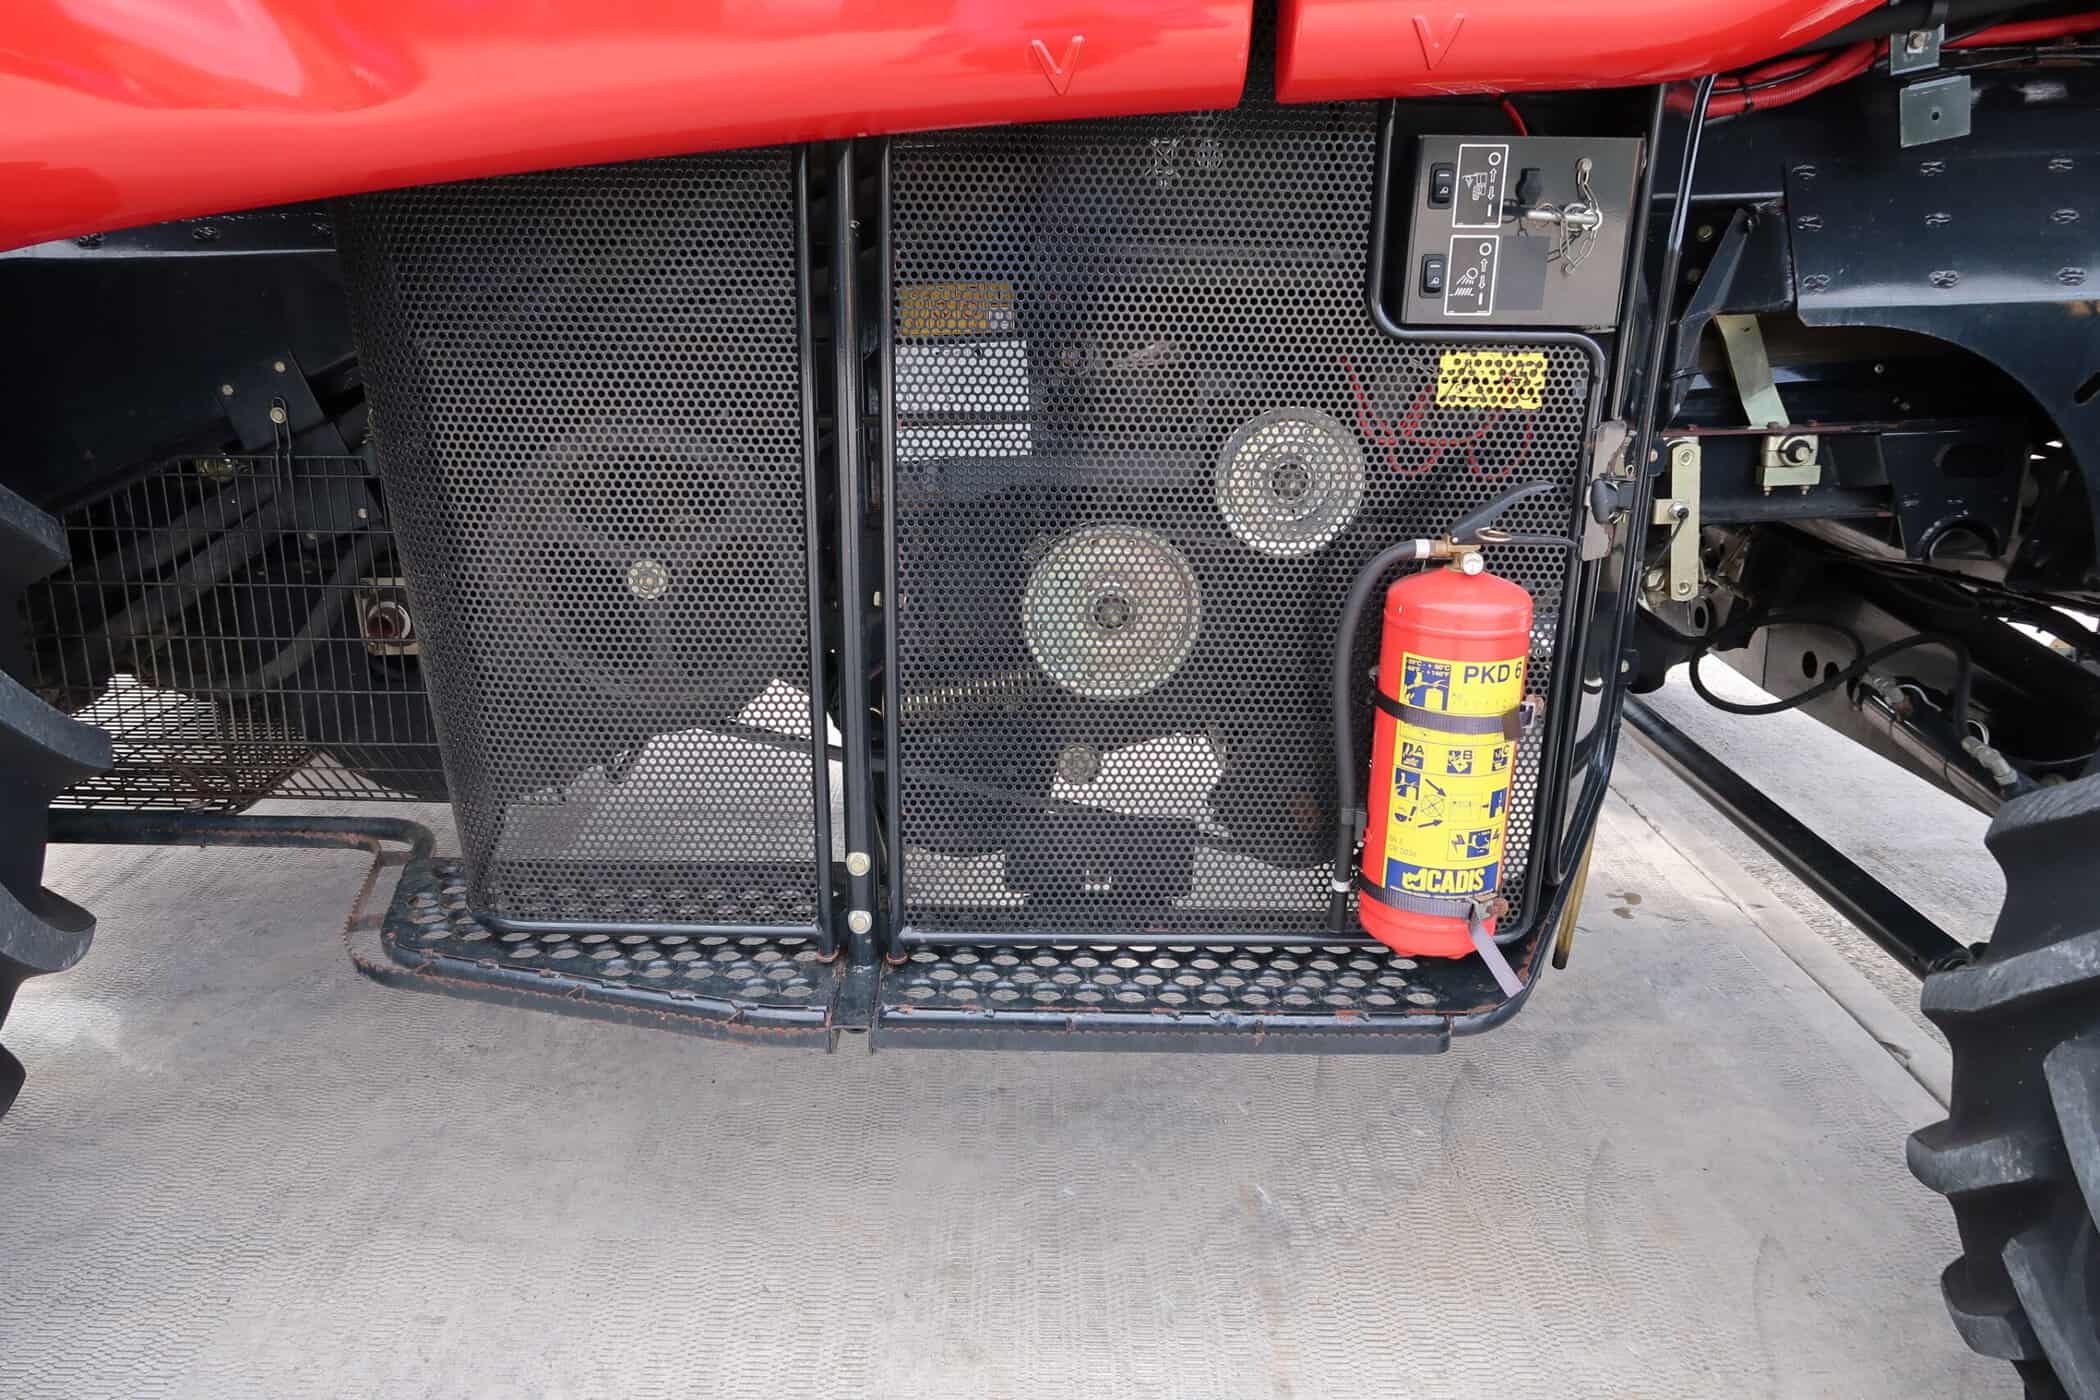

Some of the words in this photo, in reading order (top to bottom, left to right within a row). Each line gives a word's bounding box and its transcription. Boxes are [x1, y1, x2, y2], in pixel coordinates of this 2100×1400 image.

[1464, 664, 1510, 684] PKD
[1514, 661, 1523, 679] 6
[1414, 745, 1424, 755] A
[1463, 750, 1472, 760] B
